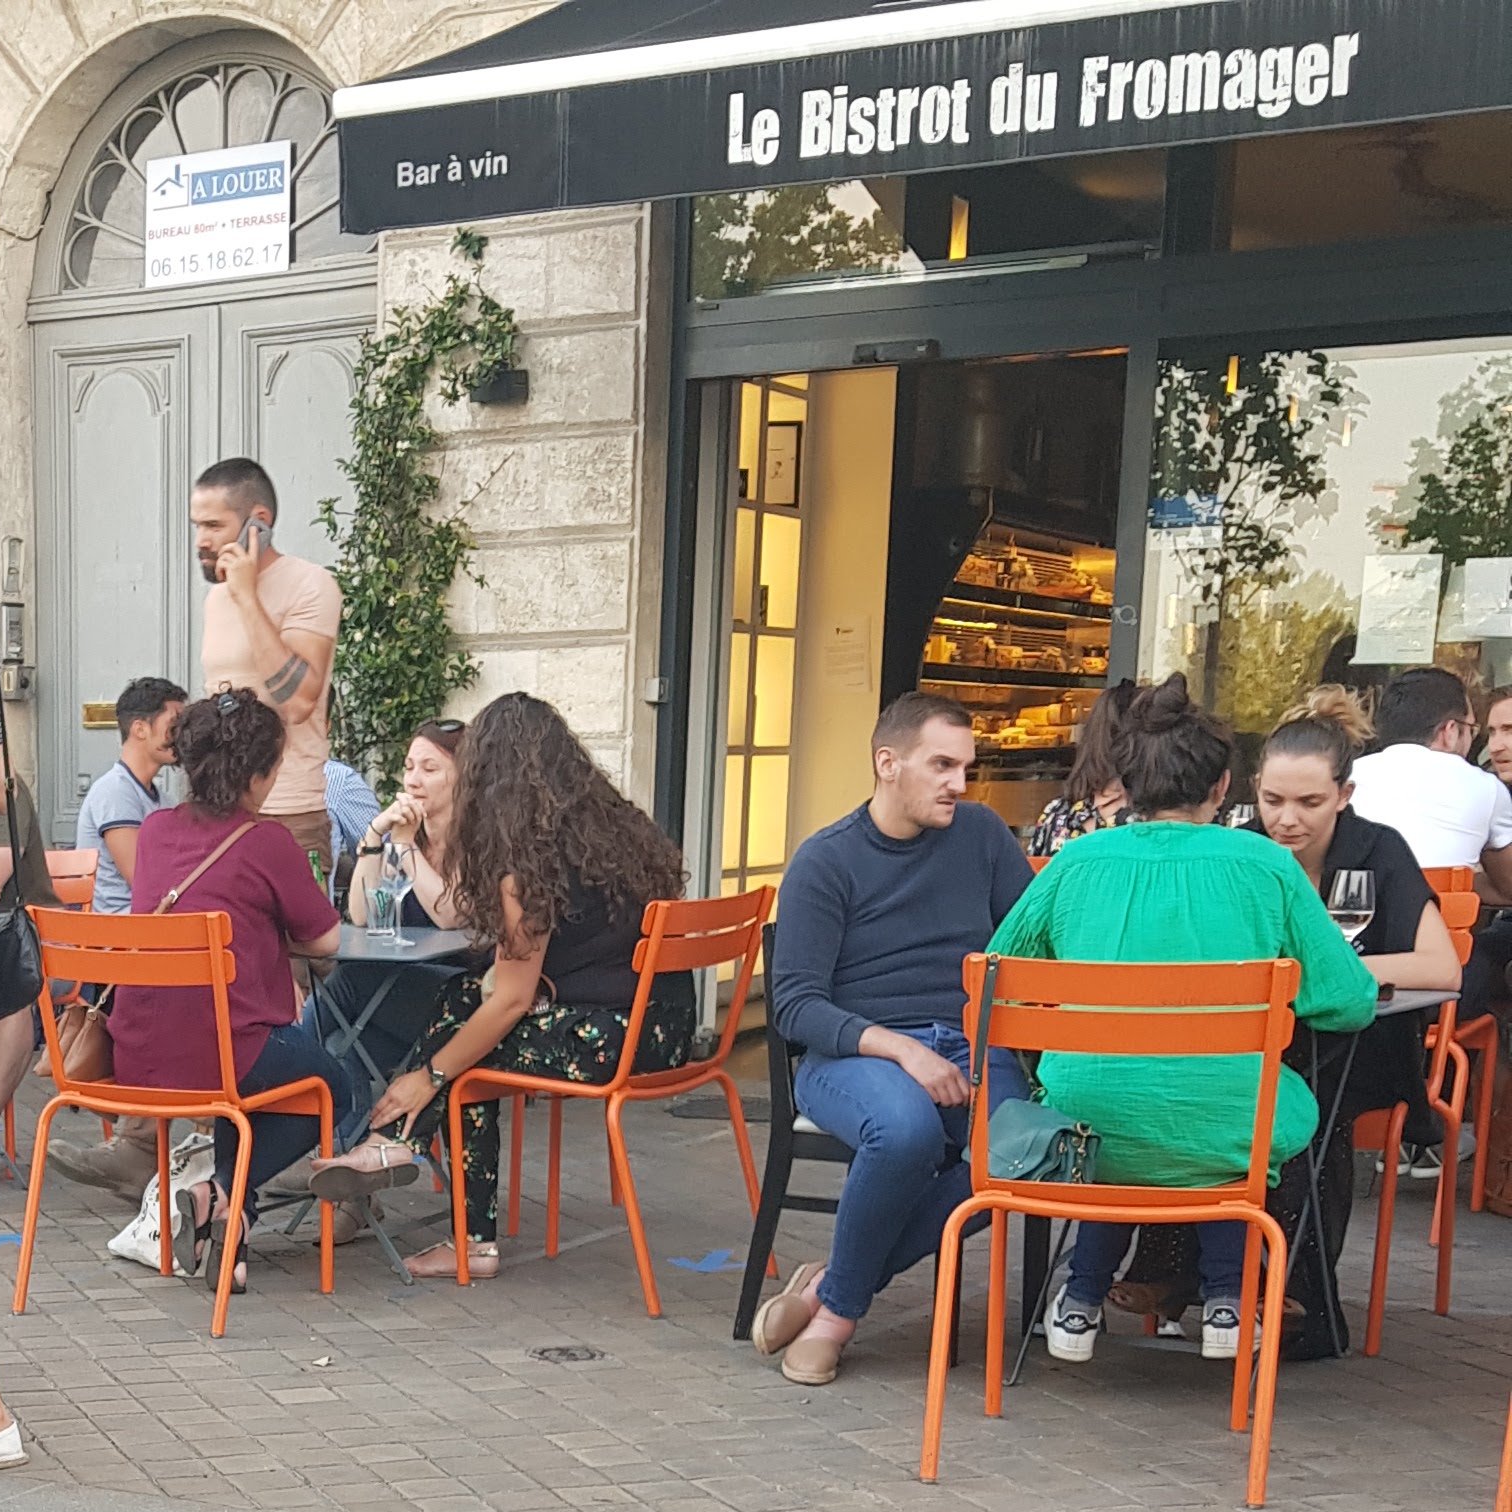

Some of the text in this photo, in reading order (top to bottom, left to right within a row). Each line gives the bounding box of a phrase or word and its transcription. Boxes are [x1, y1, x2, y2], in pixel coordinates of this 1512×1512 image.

[727, 32, 1360, 166] Le Bistrot du Fromager
[193, 168, 283, 199] A LOUER
[396, 150, 508, 188] Bar à vin
[148, 226, 190, 240] BUREAU
[231, 213, 286, 228] TERRASSE
[151, 244, 282, 277] 06.15.18.62.17
